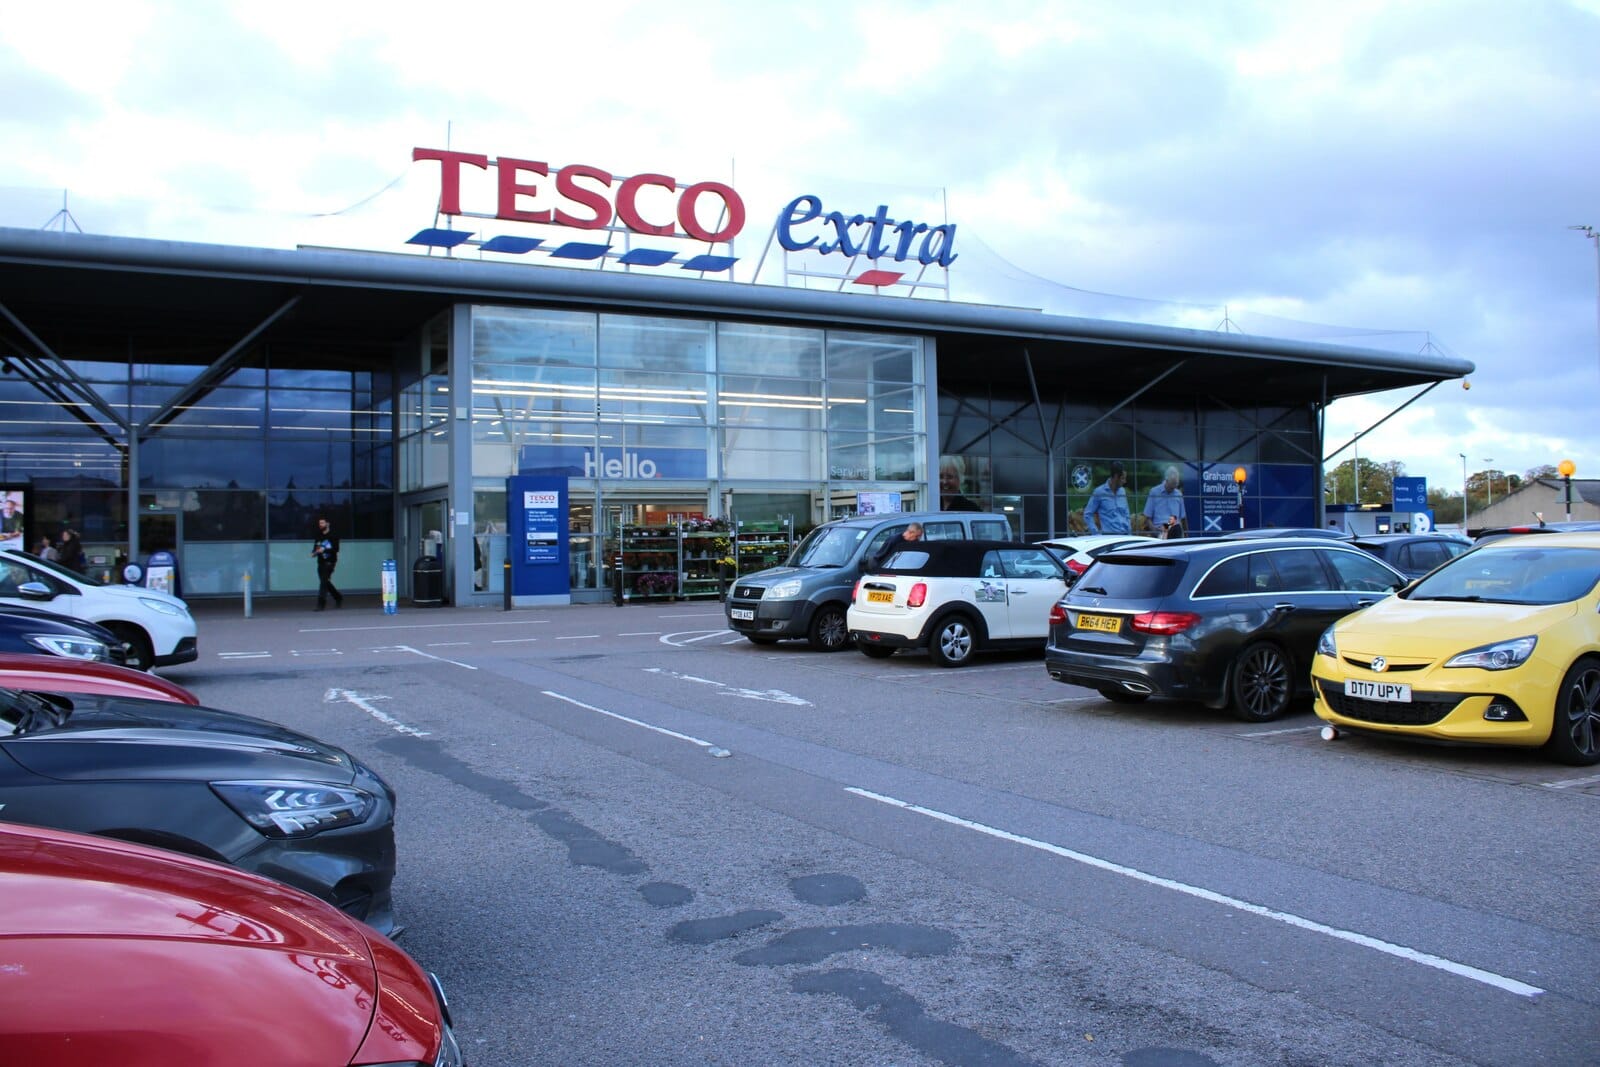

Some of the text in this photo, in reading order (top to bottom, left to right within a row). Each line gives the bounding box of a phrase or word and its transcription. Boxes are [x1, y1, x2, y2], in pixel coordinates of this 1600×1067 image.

[411, 147, 959, 267] TESCO extra
[1203, 482, 1226, 495] family
[1351, 681, 1402, 699] DT17 UPY
